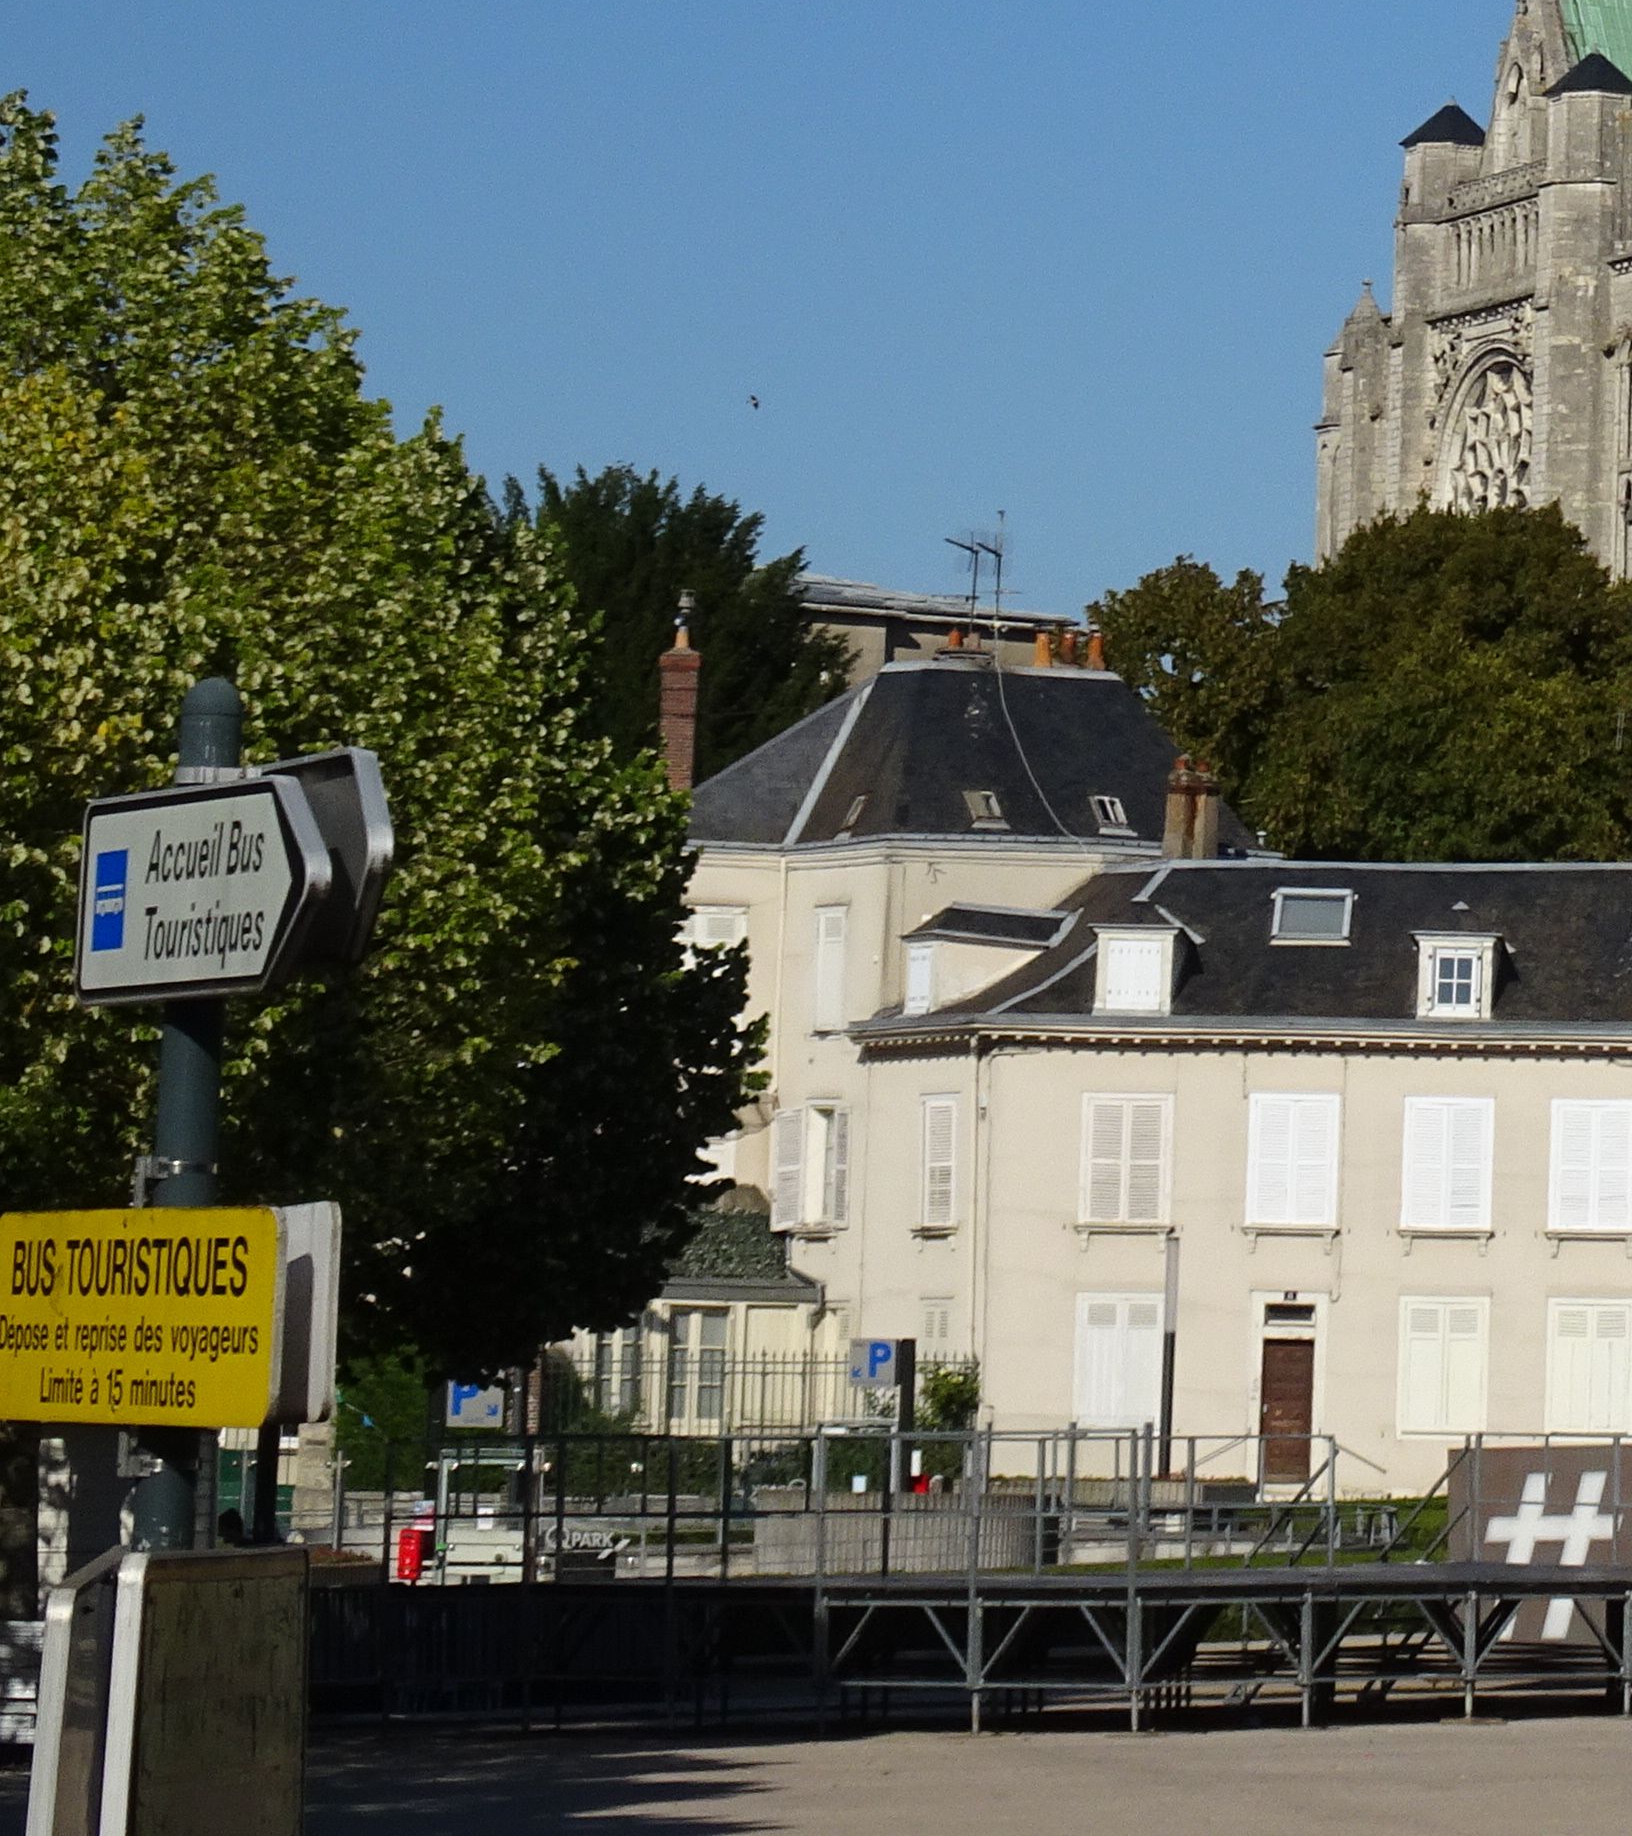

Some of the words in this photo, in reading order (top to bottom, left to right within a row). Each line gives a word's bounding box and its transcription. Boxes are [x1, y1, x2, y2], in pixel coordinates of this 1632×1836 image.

[145, 821, 224, 884] Accueil
[226, 820, 265, 876] Bus
[144, 900, 265, 970] Touristiques
[11, 1238, 56, 1297] BUS
[66, 1236, 250, 1297] TOURISTIQUES
[0, 1315, 49, 1358] Dépose
[54, 1317, 70, 1352] et
[74, 1315, 128, 1359] reprise
[134, 1315, 163, 1353] des
[171, 1324, 259, 1363] voyageurs
[40, 1367, 84, 1406] Limité
[90, 1368, 100, 1406] à
[106, 1368, 125, 1407] 15
[129, 1368, 196, 1408] minutes
